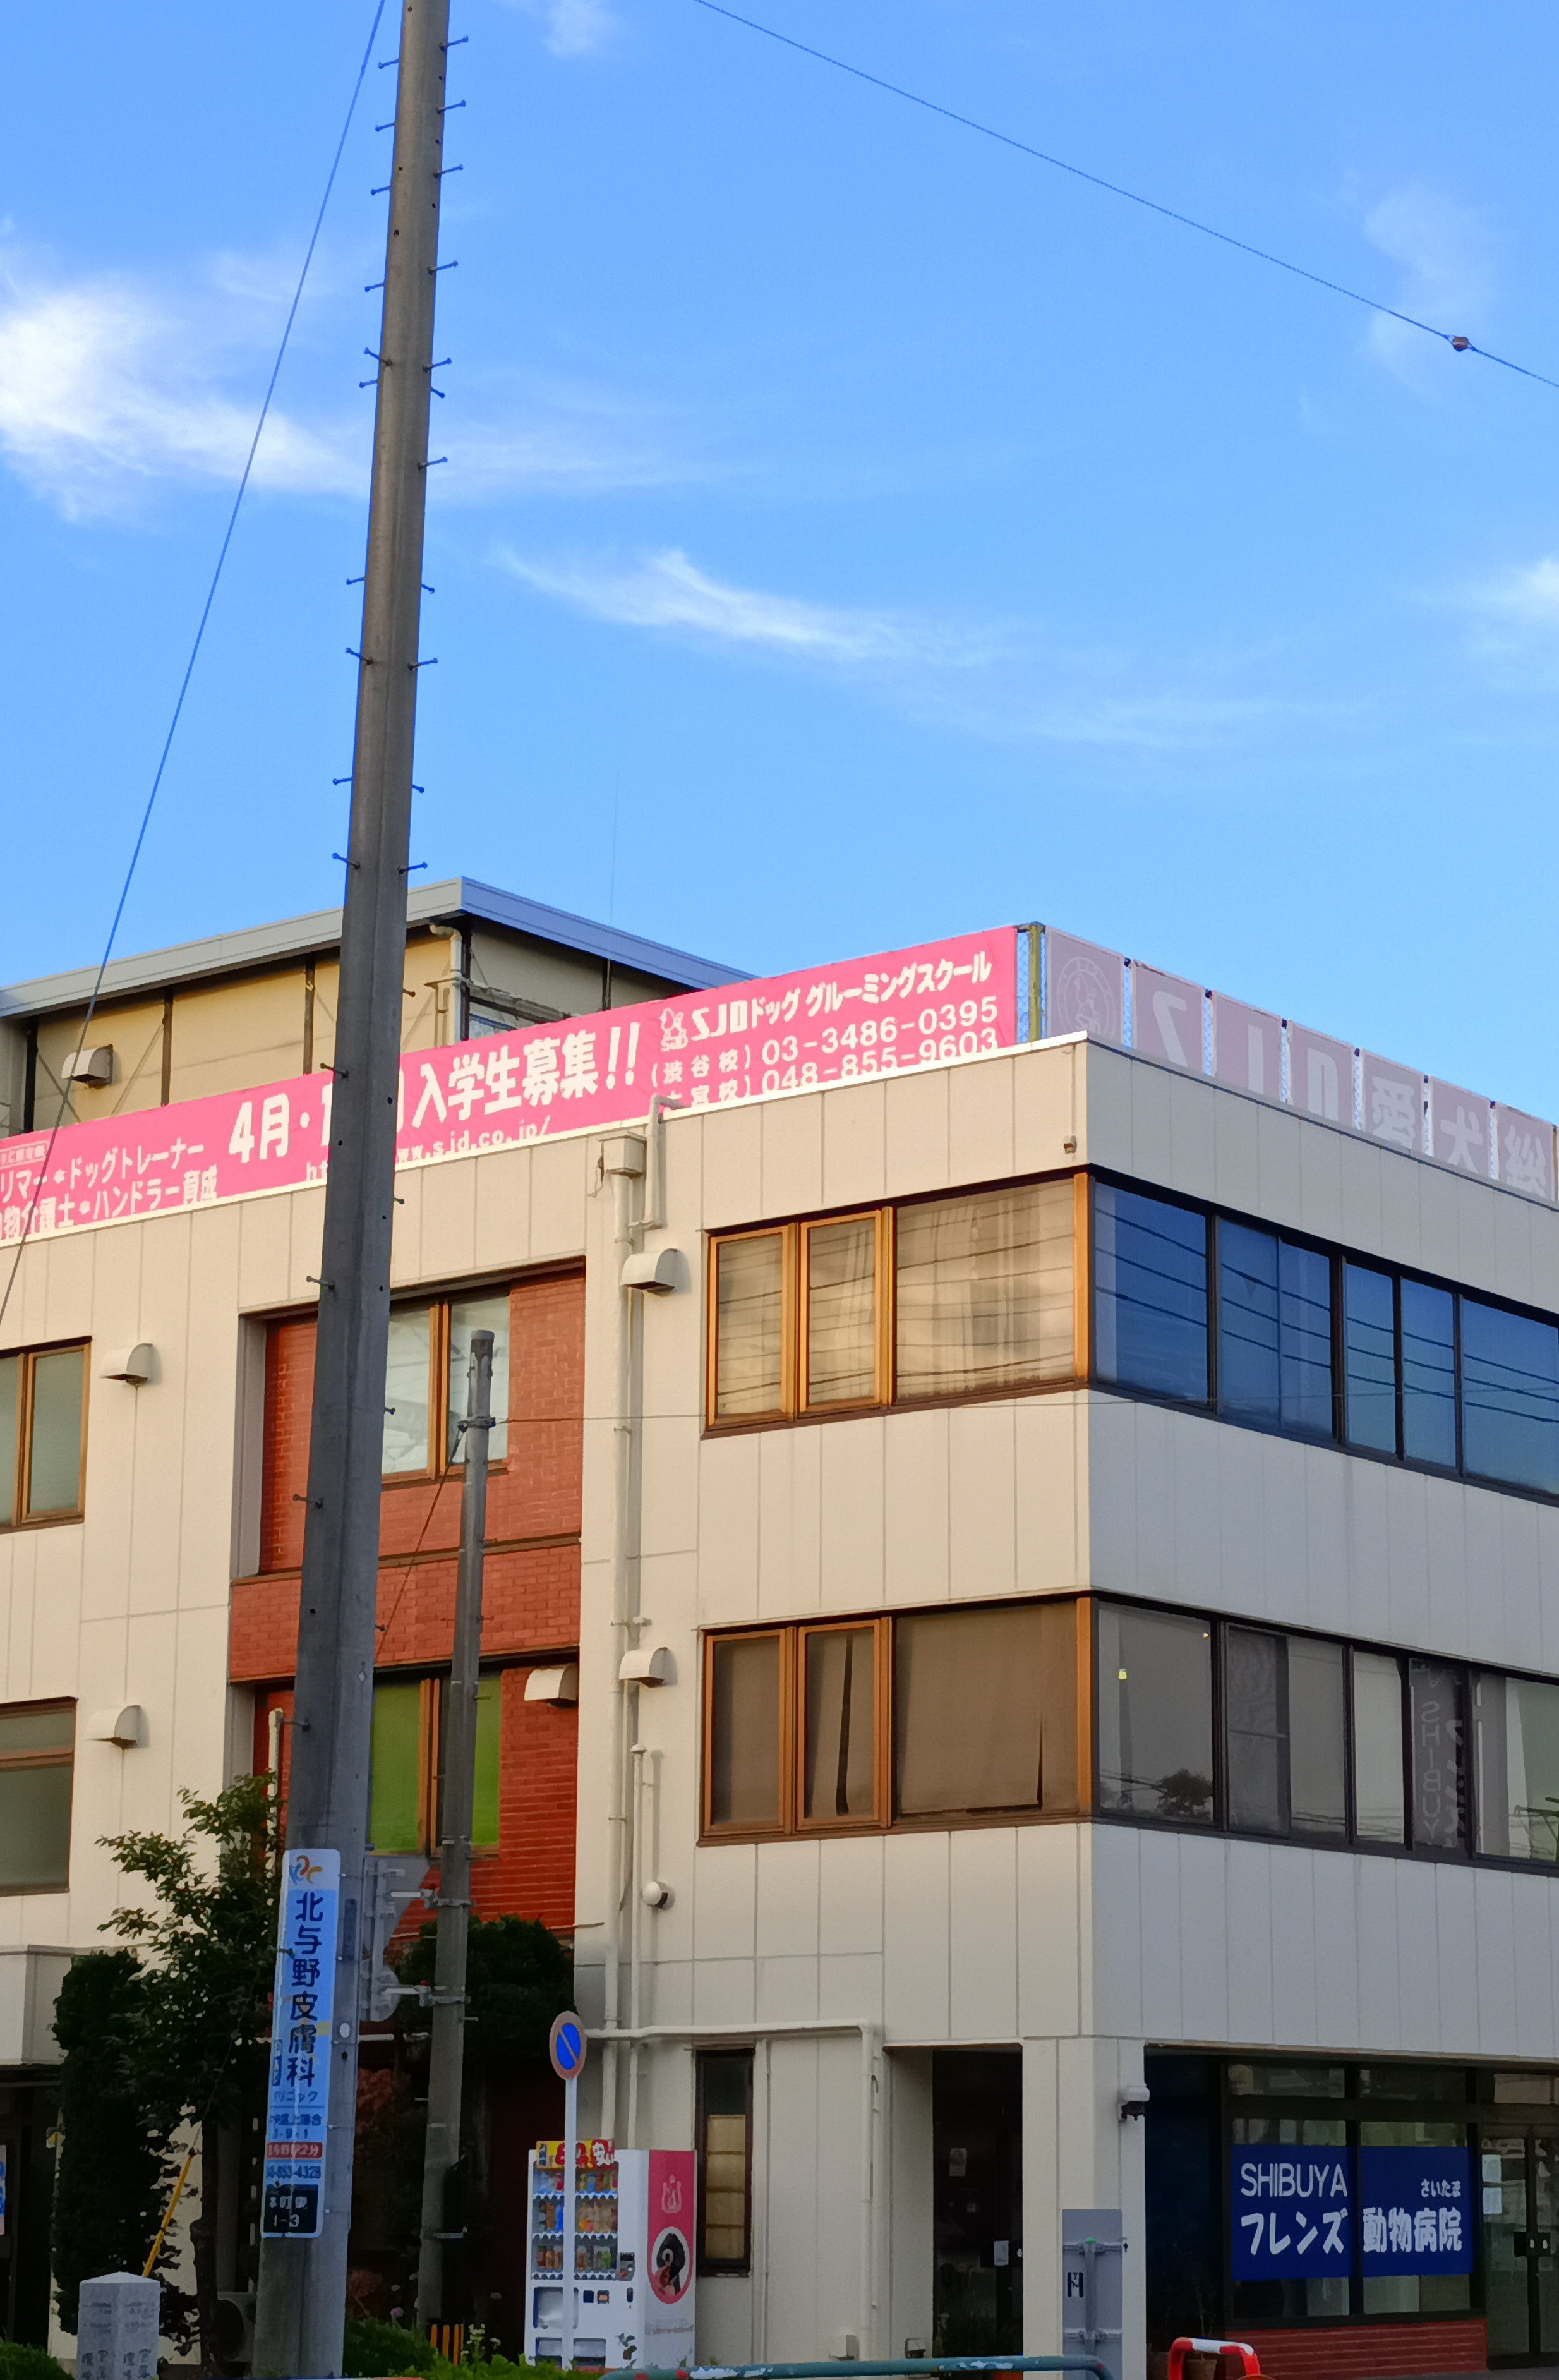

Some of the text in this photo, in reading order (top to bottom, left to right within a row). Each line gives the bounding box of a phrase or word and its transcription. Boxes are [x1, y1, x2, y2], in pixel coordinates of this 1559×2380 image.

[761, 1027, 998, 1094] 048-855-9603
[762, 996, 998, 1065] 03-3486-0395
[0, 1163, 218, 1238] 物介護士・ハンドラー育成
[287, 1891, 324, 2087] 北与野皮膚科
[1240, 2162, 1348, 2197] SHIBUYA
[1421, 2179, 1462, 2197] さいたま
[1241, 2206, 1463, 2255] フレンズ 動物病院
